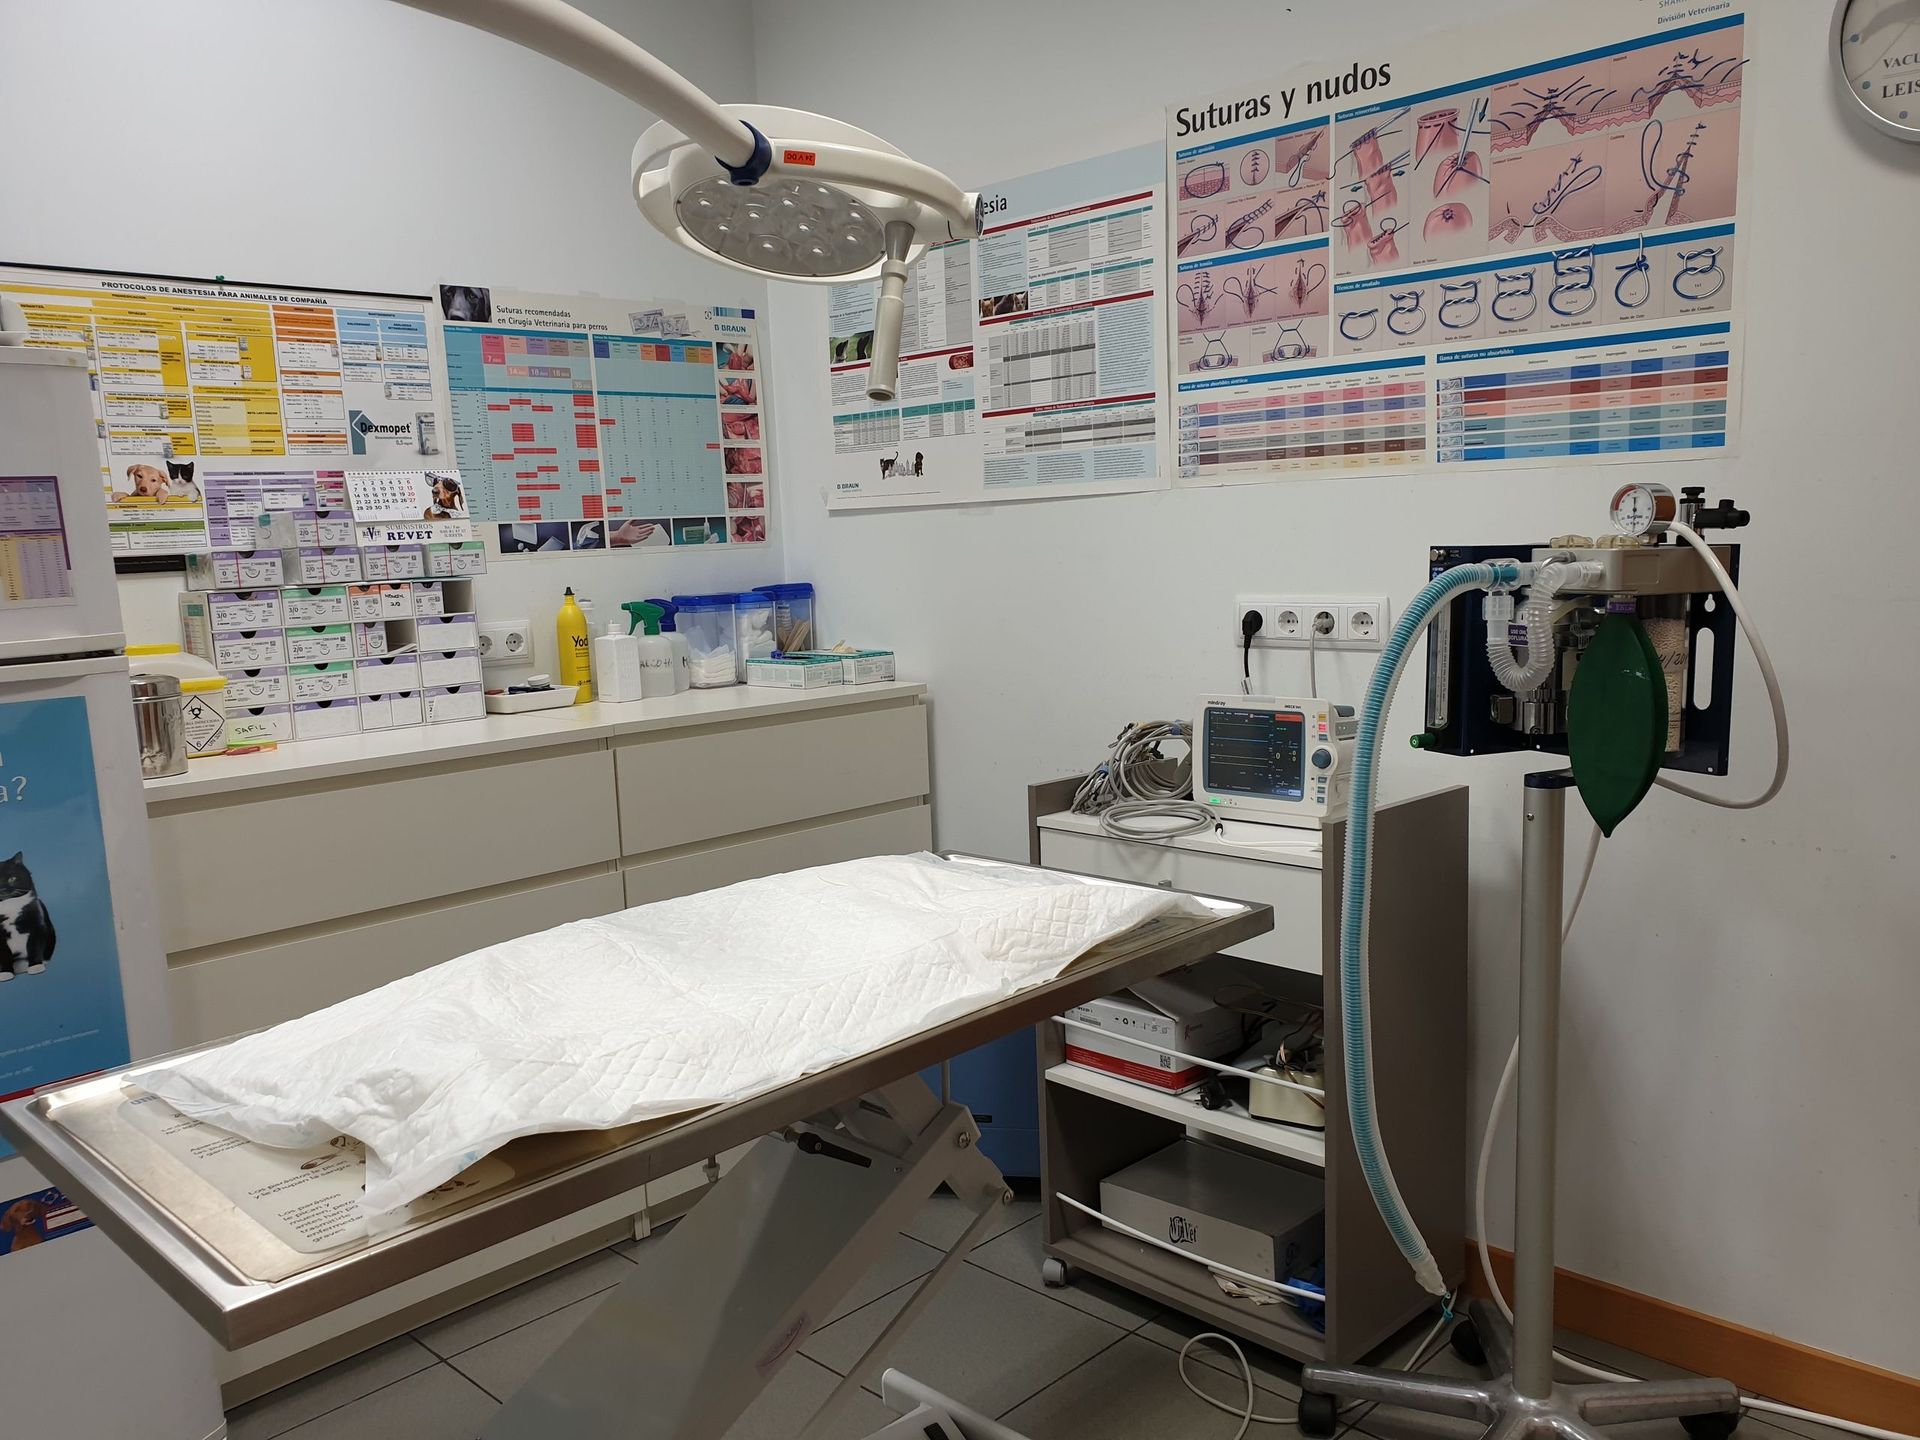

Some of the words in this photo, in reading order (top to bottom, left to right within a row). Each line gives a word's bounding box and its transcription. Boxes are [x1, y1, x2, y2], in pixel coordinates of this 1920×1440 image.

[1658, 12, 1686, 24] División
[1688, 2, 1731, 17] Veterinaria
[1176, 94, 1271, 137] Suturas
[1281, 88, 1296, 119] y
[1307, 63, 1392, 105] nudos
[101, 281, 157, 292] PROTOCOLOS
[172, 287, 216, 297] ANESTESIA
[218, 290, 238, 299] PARA
[240, 292, 278, 302] ANIMALES
[1336, 283, 1354, 292] Técnicas
[496, 305, 523, 316] Suturas
[524, 308, 571, 319] recomendadas
[508, 316, 533, 328] Cirugía
[534, 318, 571, 329] Veterinaria
[572, 323, 587, 331] para
[589, 324, 608, 332] perros
[721, 325, 746, 333] BRAUN
[1439, 354, 1454, 362] Gama
[360, 422, 411, 435] Dexmopet
[387, 531, 433, 541] REVET
[289, 607, 299, 615] 3/0
[220, 651, 231, 660] 2/0
[293, 647, 304, 655] 2/0
[235, 725, 266, 735] SAFIL
[268, 1172, 311, 1190] parásitos
[322, 1160, 347, 1171] pican
[273, 1179, 309, 1193] chupan
[321, 1164, 351, 1177] sangre
[277, 1209, 296, 1217] Los
[298, 1193, 341, 1211] parásitos
[295, 1206, 323, 1218] pican
[289, 1210, 332, 1226] mueren,
[332, 1200, 356, 1211] pero
[295, 1219, 322, 1230] antes
[324, 1210, 344, 1219] han
[312, 1228, 346, 1243] graves
